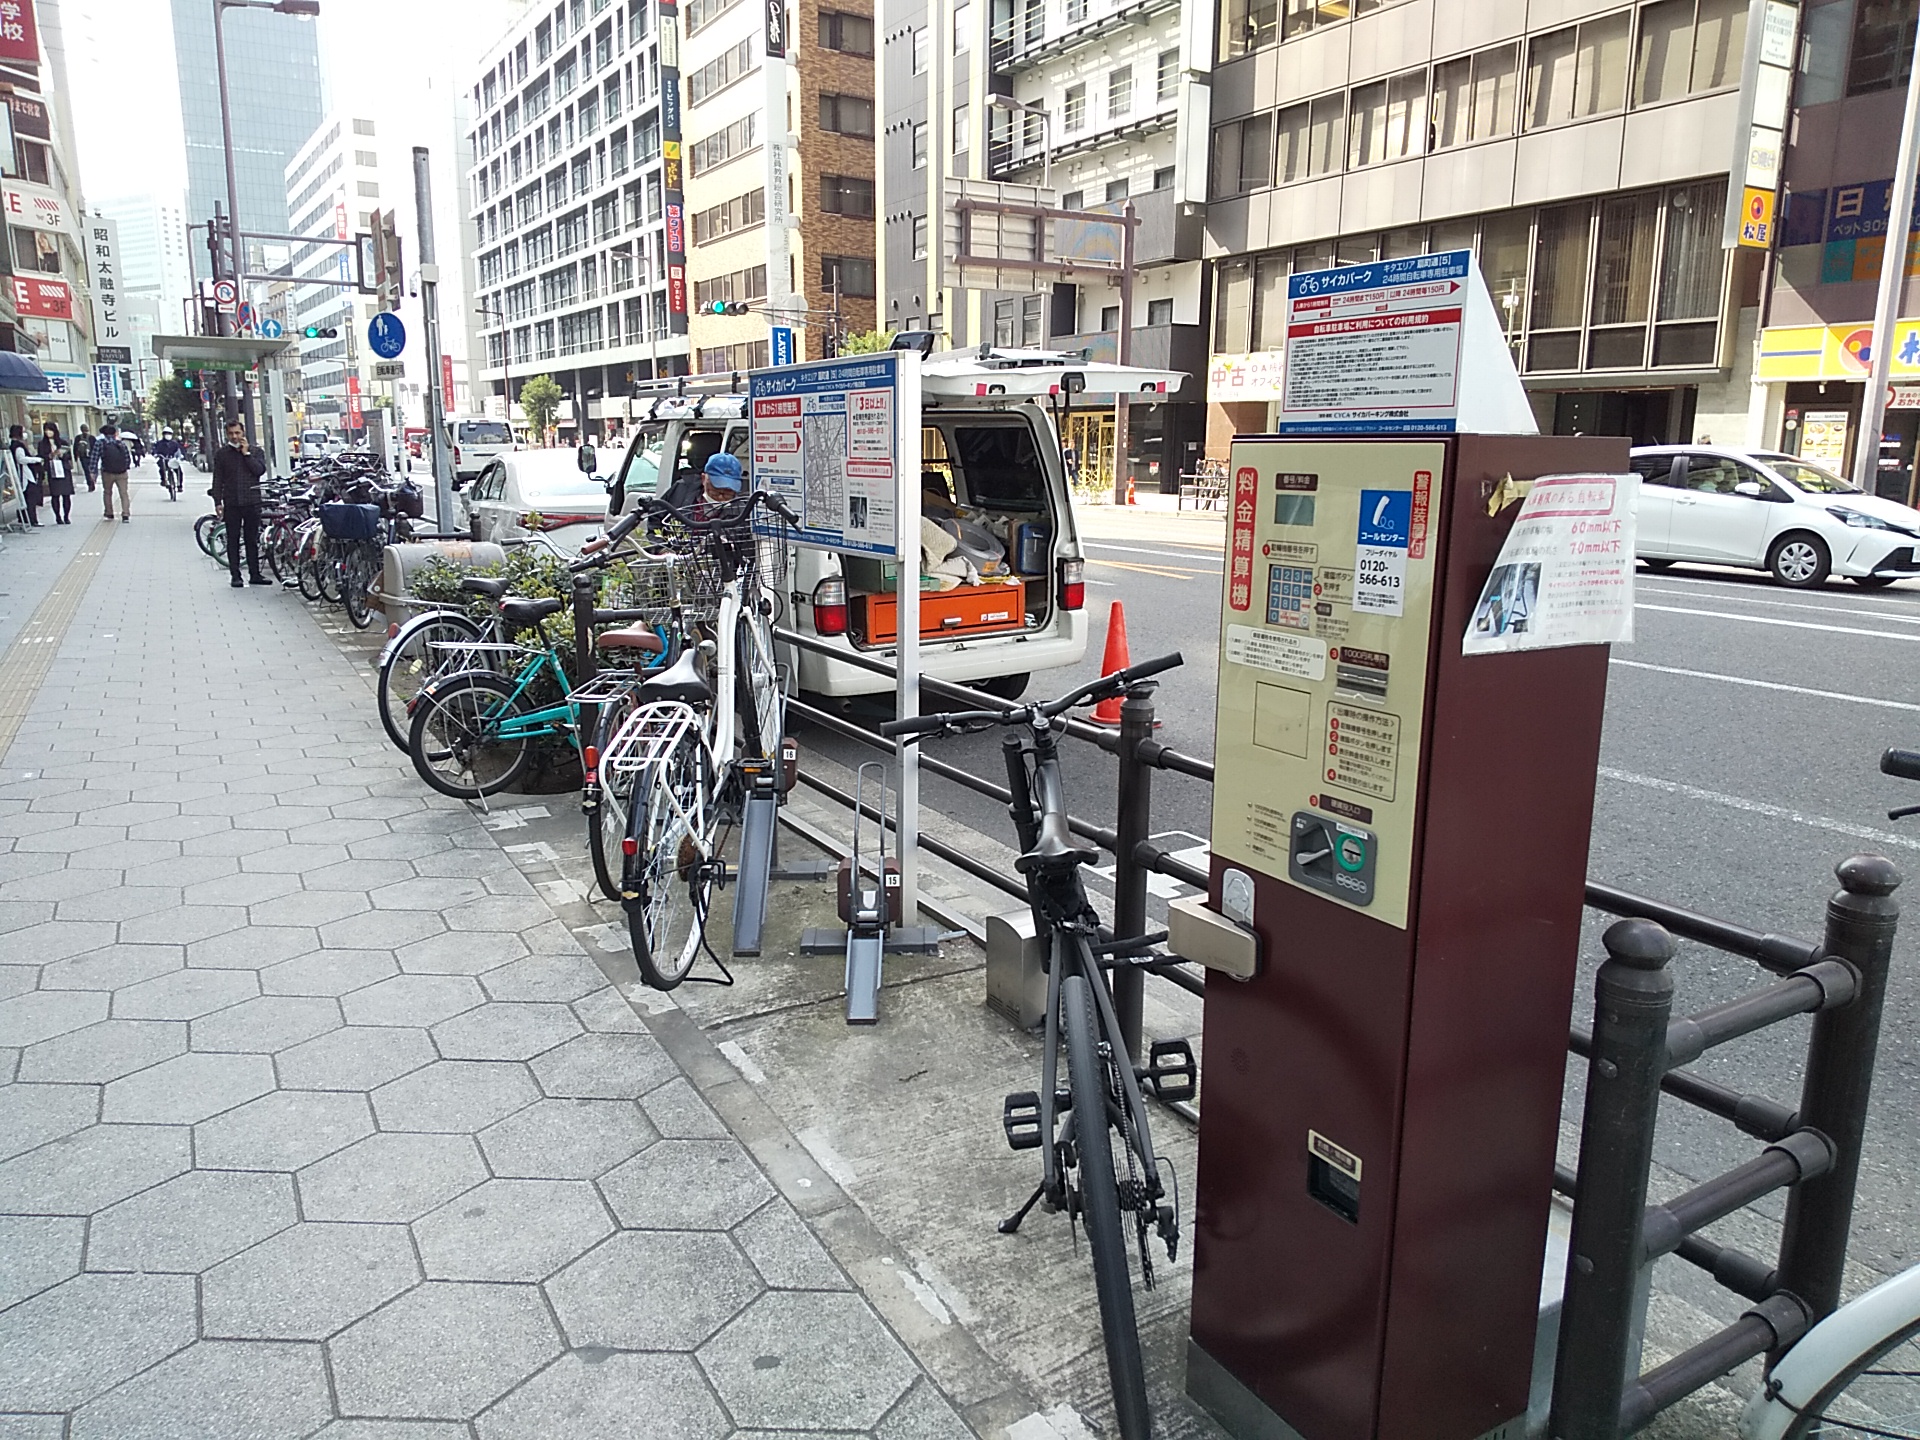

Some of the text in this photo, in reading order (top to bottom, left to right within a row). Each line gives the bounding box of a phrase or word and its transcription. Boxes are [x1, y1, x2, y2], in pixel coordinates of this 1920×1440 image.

[1, 1, 24, 42] 学校
[1766, 23, 1792, 37] RECORDS
[46, 212, 60, 226] 3F
[1743, 222, 1767, 241] 松屋
[1383, 261, 1416, 273] キタエリア
[93, 228, 119, 338] 昭和太融寺ビル
[1322, 270, 1372, 288] サイカパーク
[1212, 367, 1246, 388] 中古
[1251, 376, 1281, 386] オフィス
[766, 377, 796, 393] サイカパーク
[1410, 473, 1430, 556] 警報装置付
[1571, 520, 1622, 535] 60mm以下
[1231, 472, 1255, 607] 料金精算機
[1361, 531, 1406, 541] コールセンター
[1365, 548, 1398, 558] フリーダイヤル
[1570, 540, 1621, 555] 70mm以下
[1360, 559, 1389, 573] 0120-
[1284, 571, 1290, 580] 2
[1294, 572, 1300, 581] 3
[1359, 573, 1400, 588] 566-613
[1273, 584, 1279, 593] 4
[1283, 585, 1289, 594] 5
[1293, 586, 1299, 595] 6
[1282, 599, 1288, 608] 8
[1292, 601, 1298, 610] 9
[785, 750, 794, 759] 16
[888, 876, 897, 885] 15
